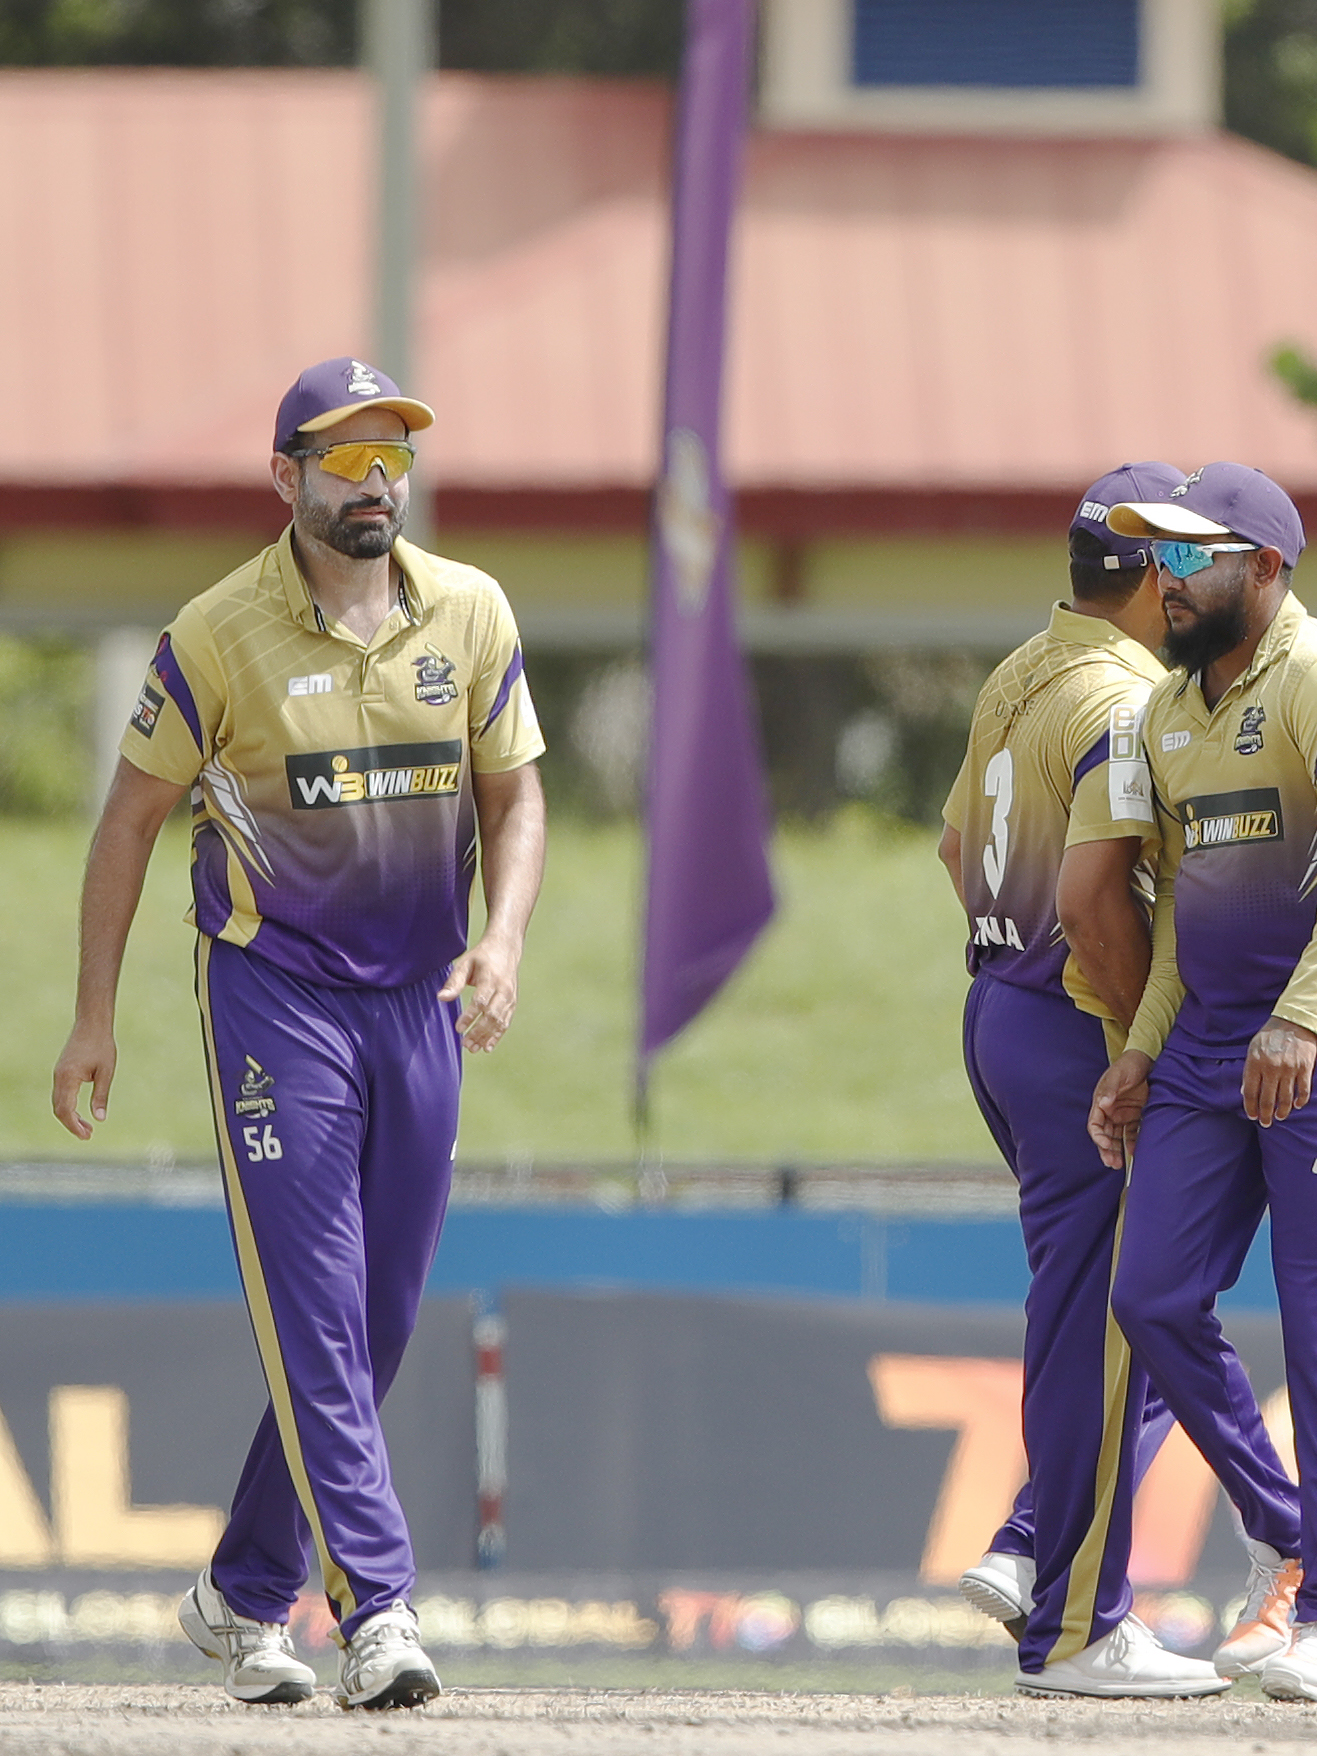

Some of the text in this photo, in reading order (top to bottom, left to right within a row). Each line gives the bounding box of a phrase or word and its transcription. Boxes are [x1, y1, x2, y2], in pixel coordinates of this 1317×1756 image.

[1080, 501, 1109, 522] EM
[288, 673, 332, 696] EM
[1161, 730, 1191, 752] EM
[367, 766, 459, 797] WINBUZZ
[983, 747, 1013, 900] 3
[1202, 812, 1273, 843] WINBUZZ
[243, 1124, 283, 1162] 56
